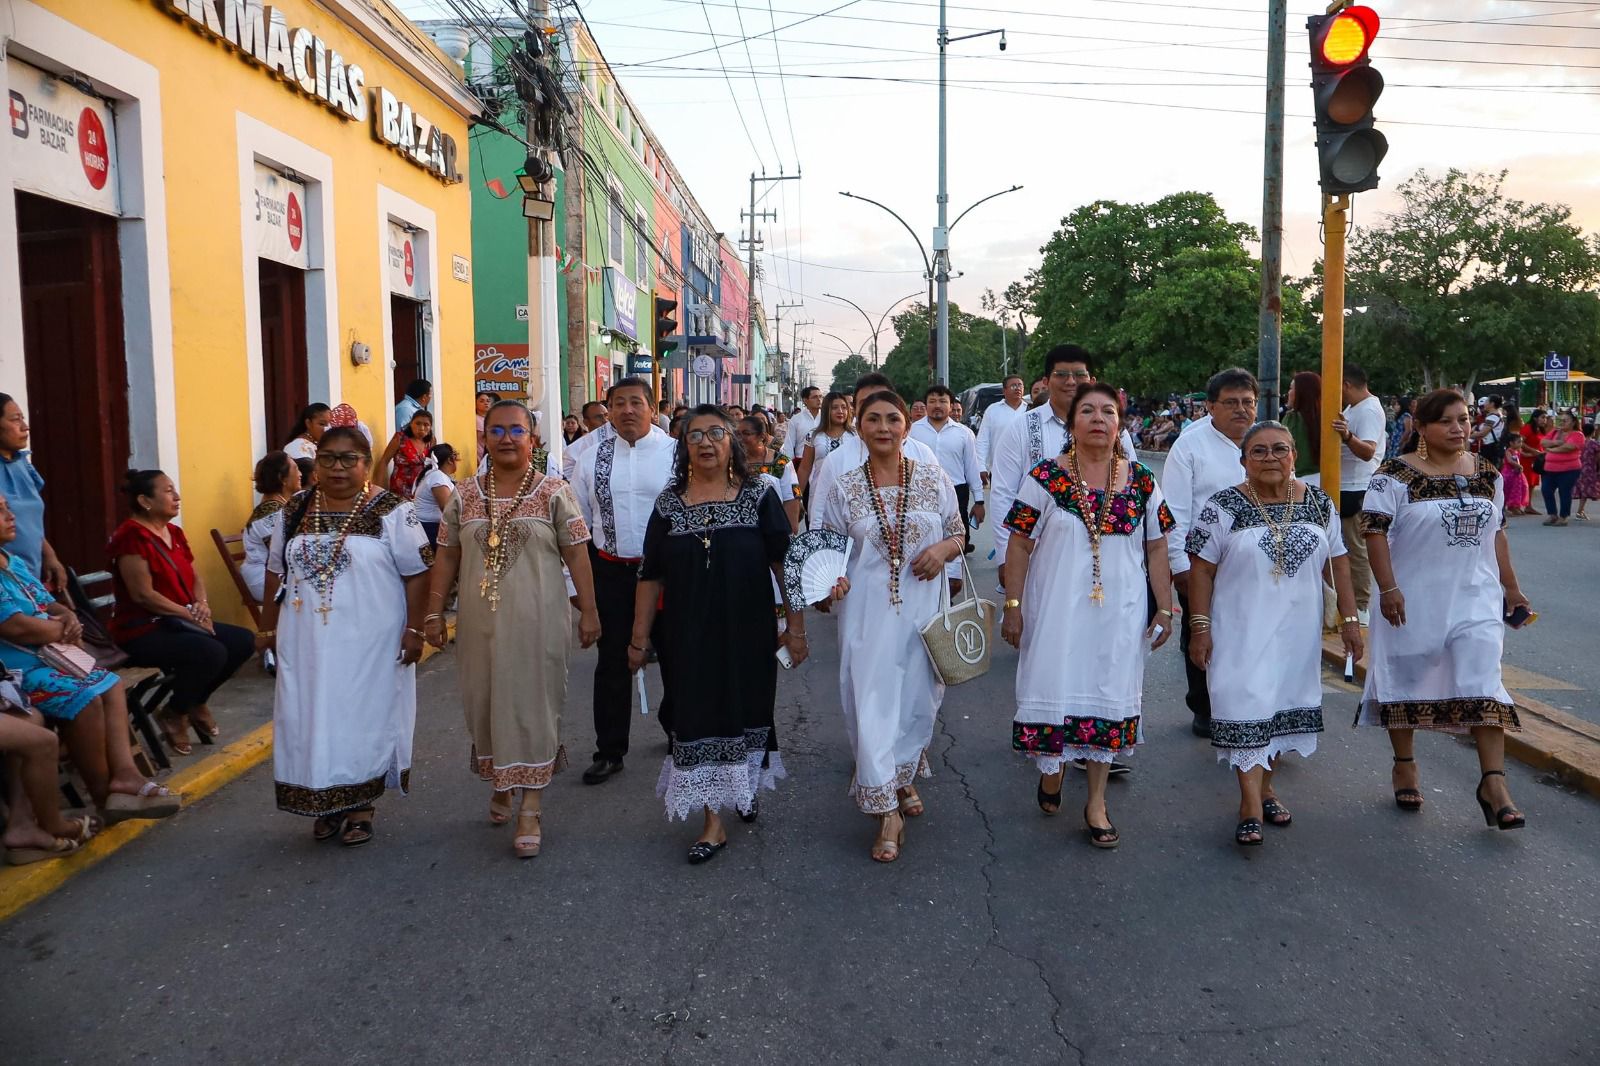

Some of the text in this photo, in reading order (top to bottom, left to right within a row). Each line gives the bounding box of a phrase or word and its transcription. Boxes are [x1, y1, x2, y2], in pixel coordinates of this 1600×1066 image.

[28, 103, 75, 138] FARMACIAS
[87, 129, 97, 146] 24
[84, 151, 105, 172] HORAS
[615, 276, 636, 321] telcel
